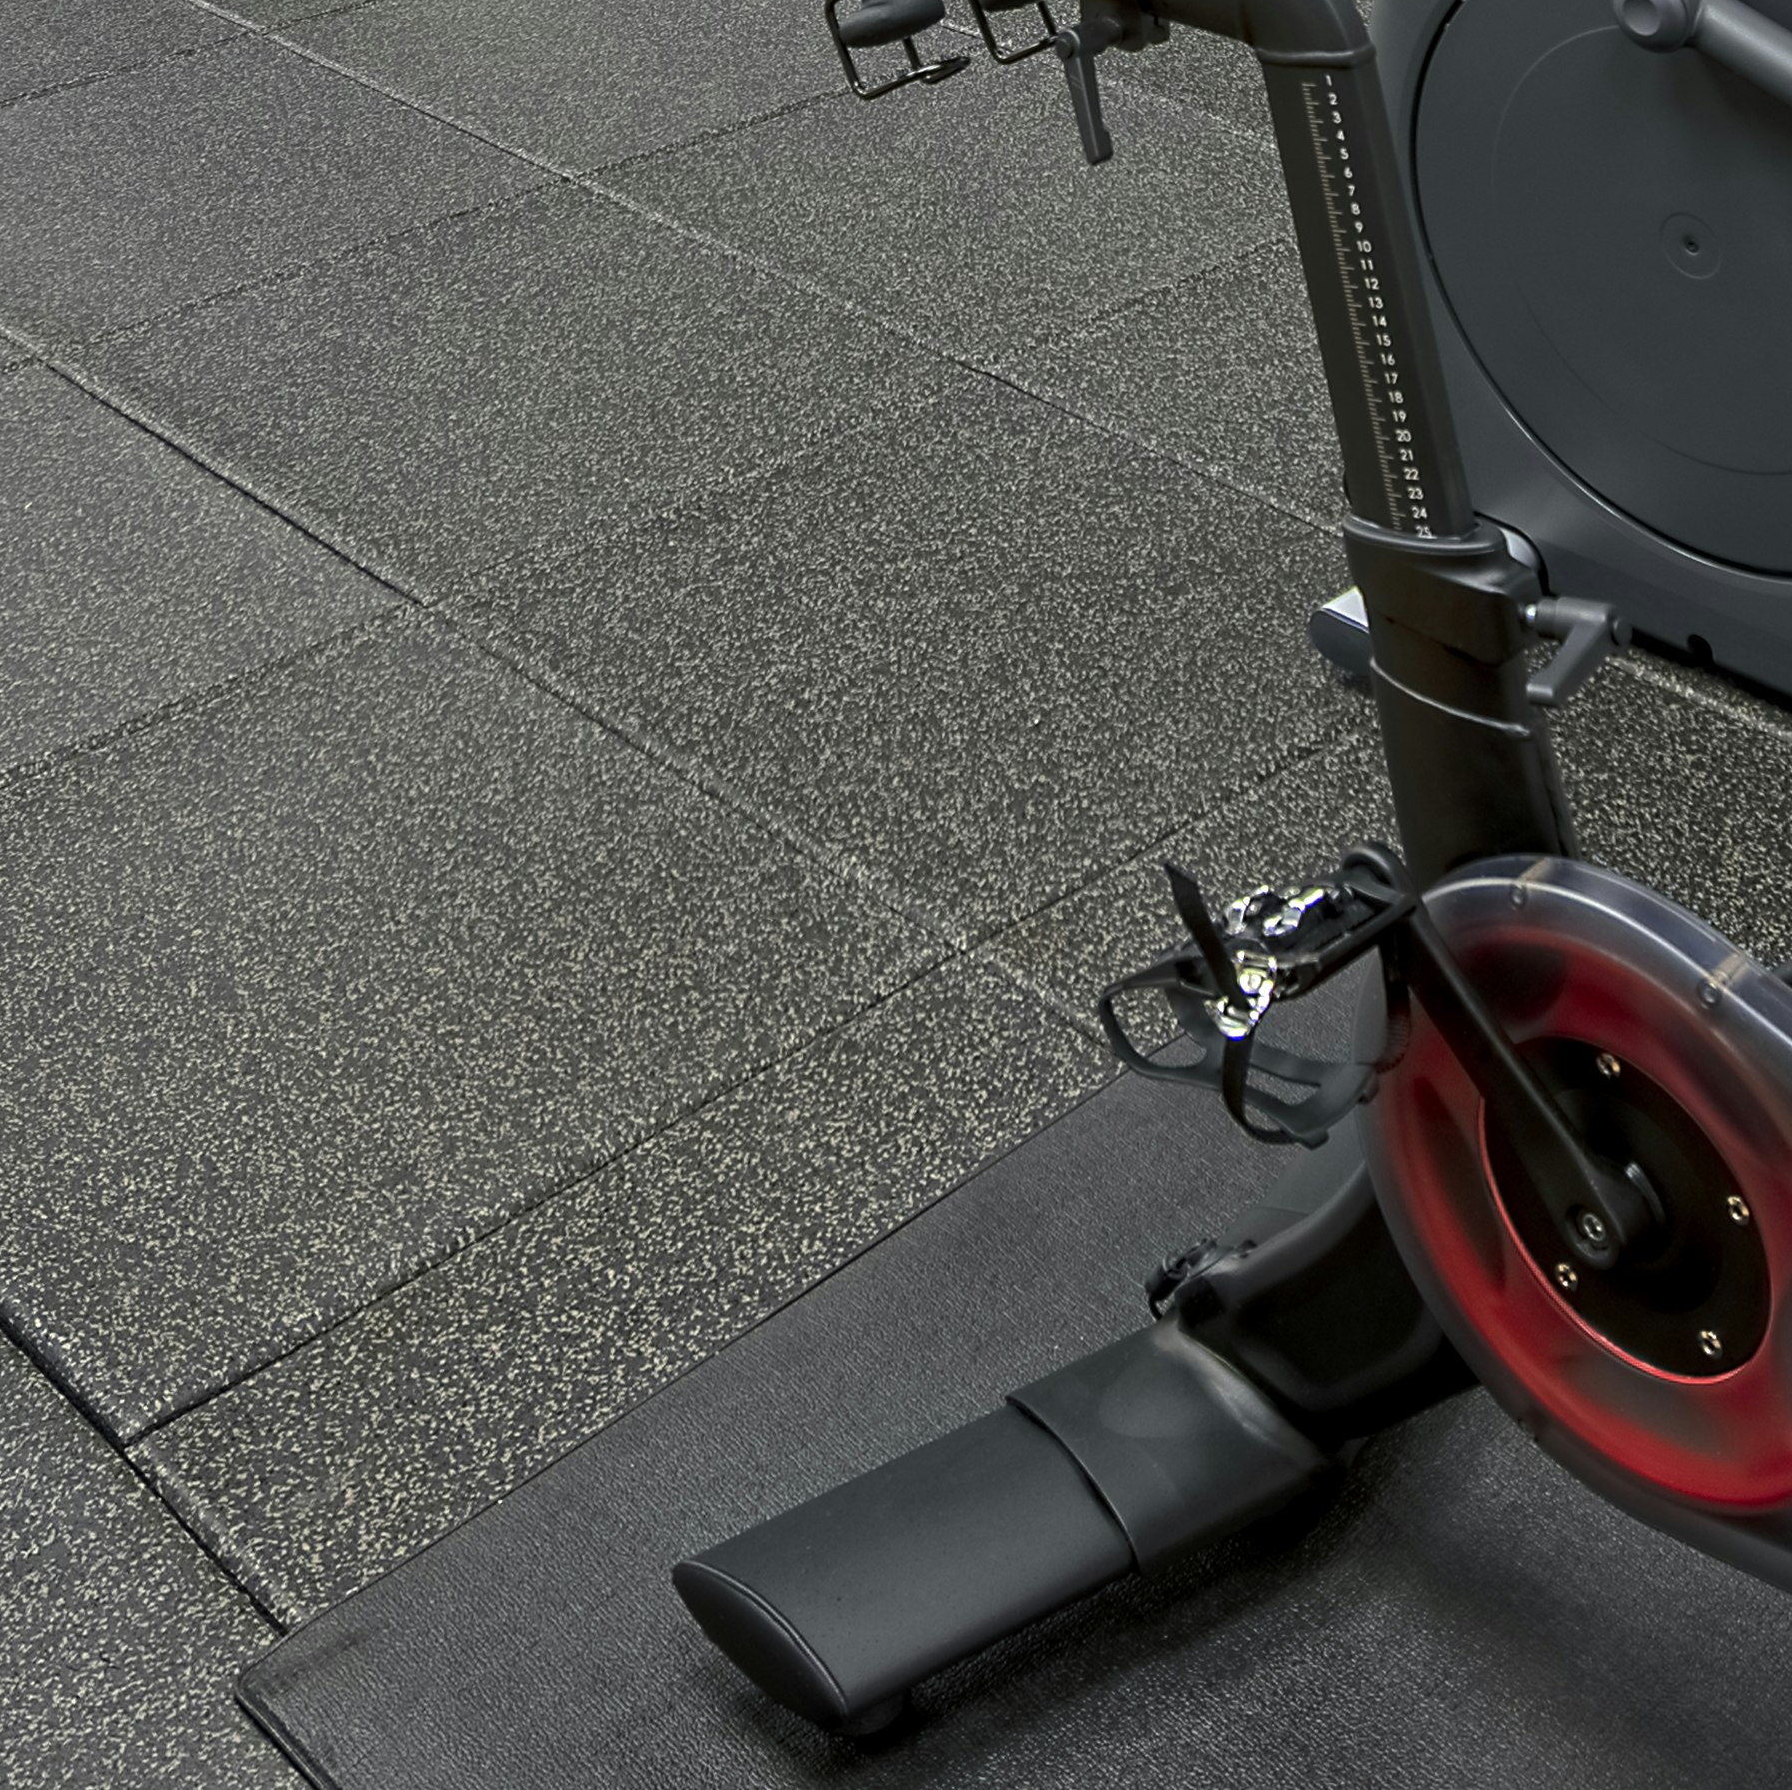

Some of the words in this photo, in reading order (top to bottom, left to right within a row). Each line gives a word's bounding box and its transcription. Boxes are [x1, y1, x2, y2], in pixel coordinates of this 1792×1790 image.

[1328, 92, 1338, 106] 2
[1332, 111, 1342, 124] 3
[1336, 130, 1345, 141] 4
[1340, 147, 1349, 160] 5
[1344, 167, 1353, 179] 6
[1348, 184, 1356, 197] 7
[1351, 203, 1361, 216] 8
[1354, 221, 1363, 233] 9
[1356, 240, 1372, 253] 10
[1360, 259, 1374, 271] 11
[1364, 277, 1379, 290] 12
[1368, 296, 1384, 309] 13
[1372, 315, 1387, 327] 14
[1376, 334, 1392, 347] 15
[1380, 353, 1396, 366] 16
[1384, 372, 1398, 384] 17
[1388, 391, 1404, 404] 18
[1392, 410, 1407, 422] 19
[1395, 429, 1412, 442] 20
[1399, 448, 1414, 461] 21
[1403, 467, 1419, 481] 22
[1407, 486, 1424, 500] 23
[1411, 506, 1428, 519] 24
